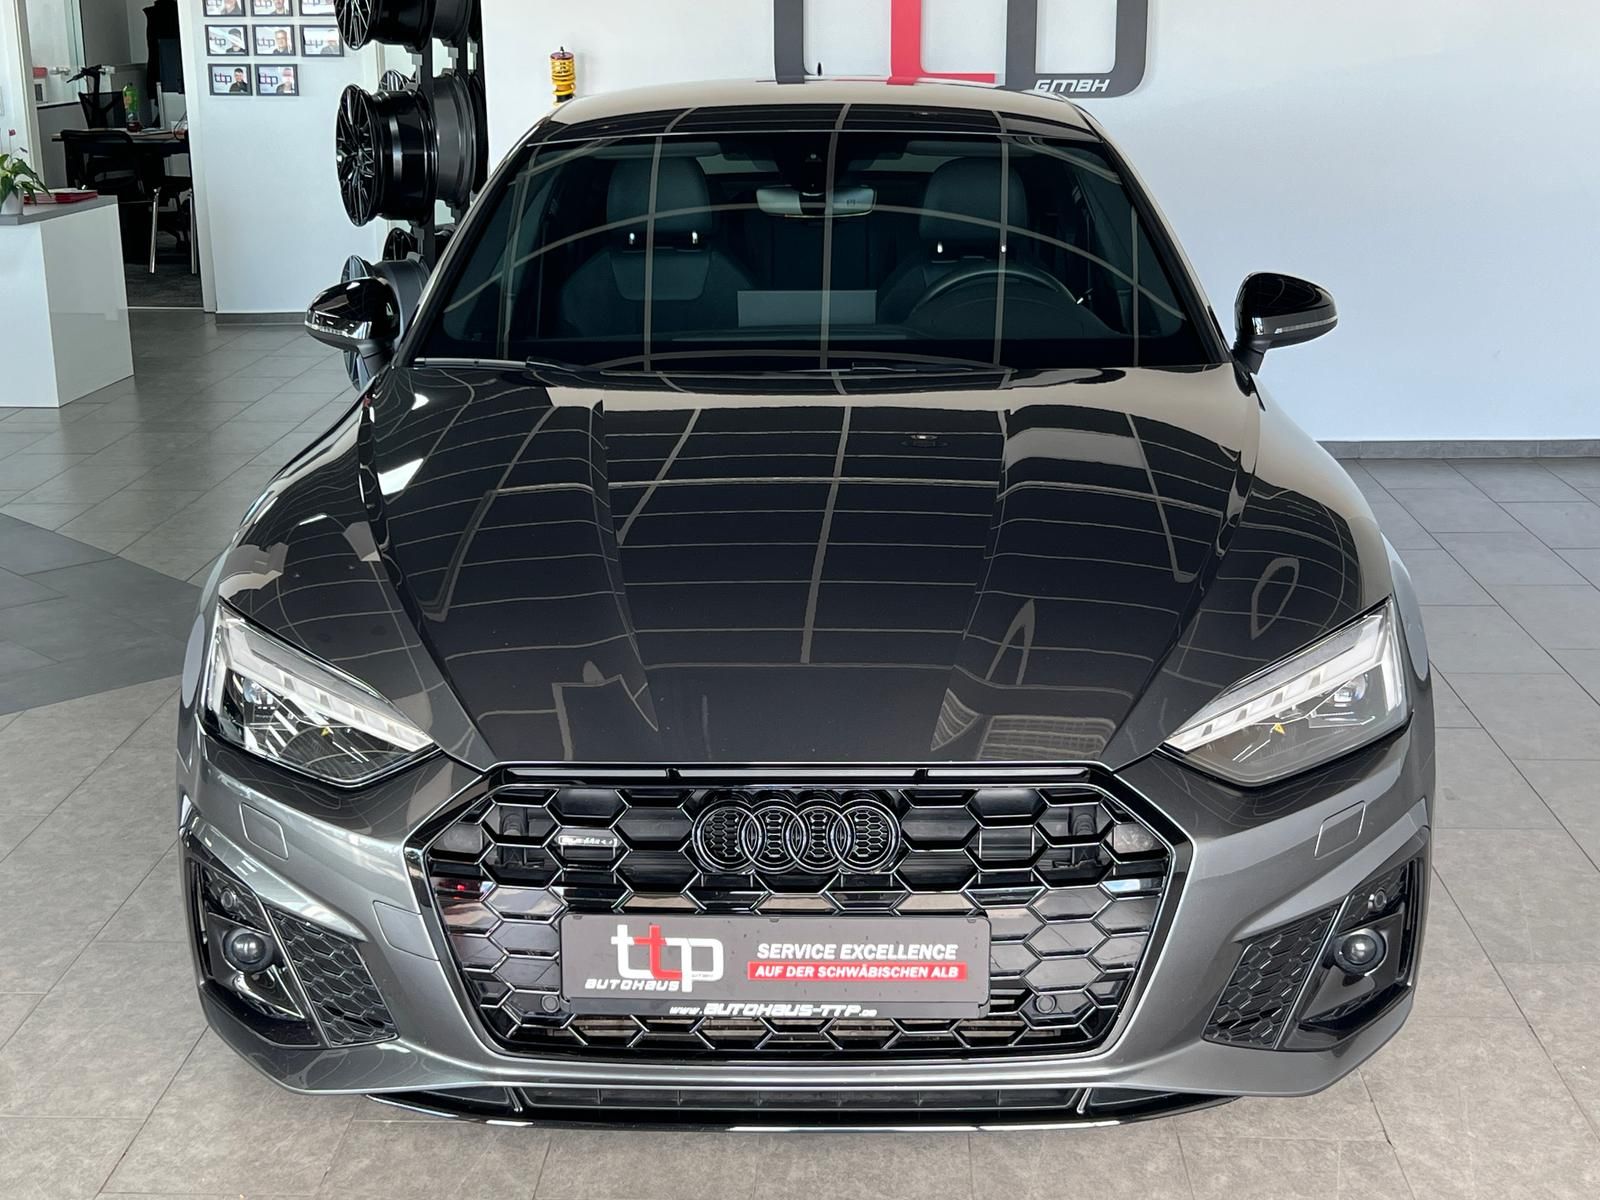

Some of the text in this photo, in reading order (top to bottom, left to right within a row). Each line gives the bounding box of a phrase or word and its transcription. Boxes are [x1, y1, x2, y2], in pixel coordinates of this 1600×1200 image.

[611, 924, 724, 992] ttp
[757, 943, 958, 960] SERVICE EXCELLENCE
[755, 964, 958, 978] AUF DER SCHWÄBISCHEN ALB
[585, 978, 680, 991] AUTOHAUS
